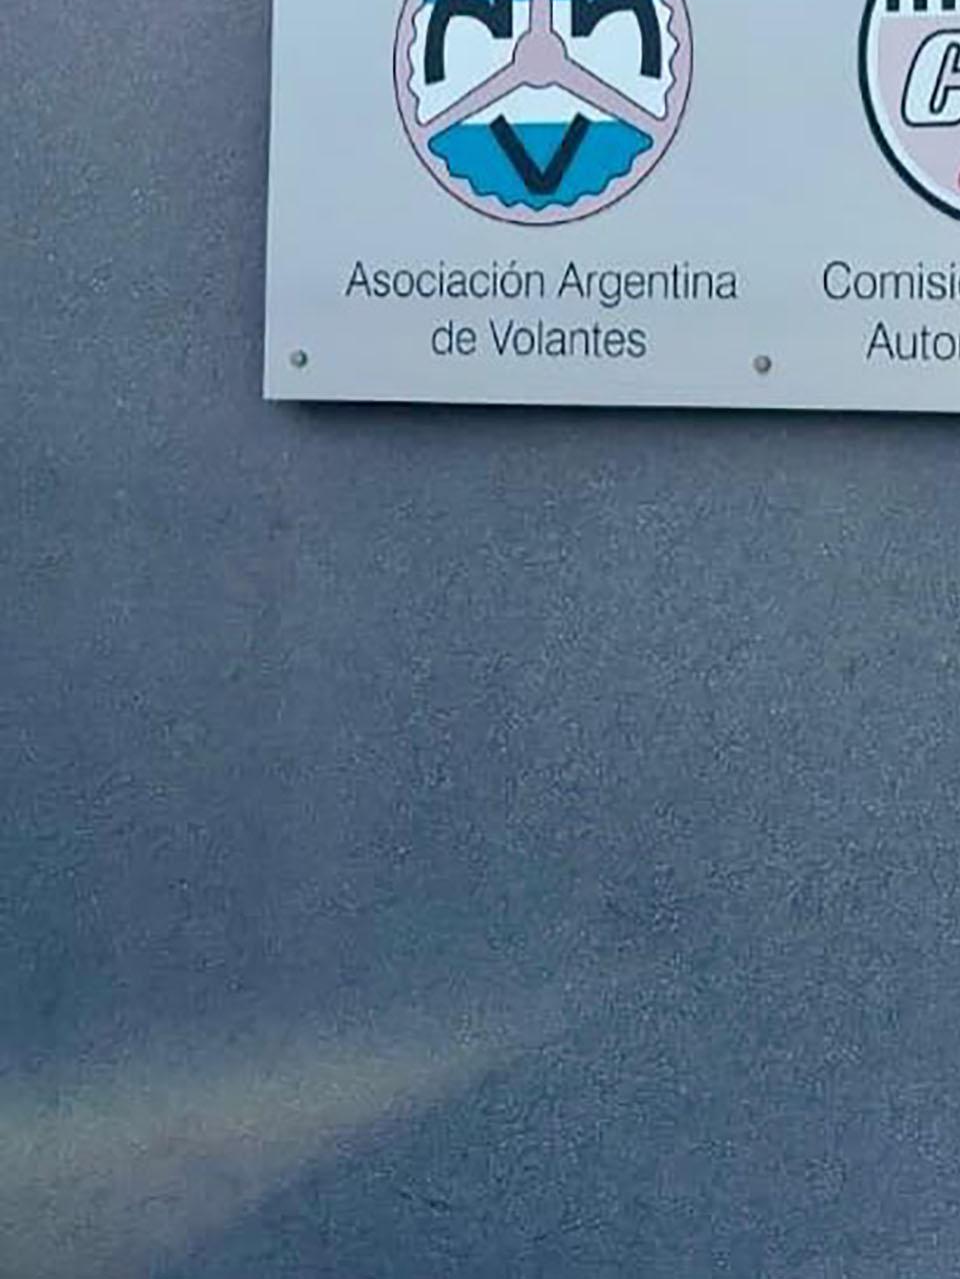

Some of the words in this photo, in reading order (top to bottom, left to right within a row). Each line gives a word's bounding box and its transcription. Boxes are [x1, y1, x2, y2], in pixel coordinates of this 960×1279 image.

[345, 259, 545, 300] Asociación
[557, 261, 738, 308] Argentina
[431, 320, 477, 356] de
[489, 320, 647, 358] Volantes
